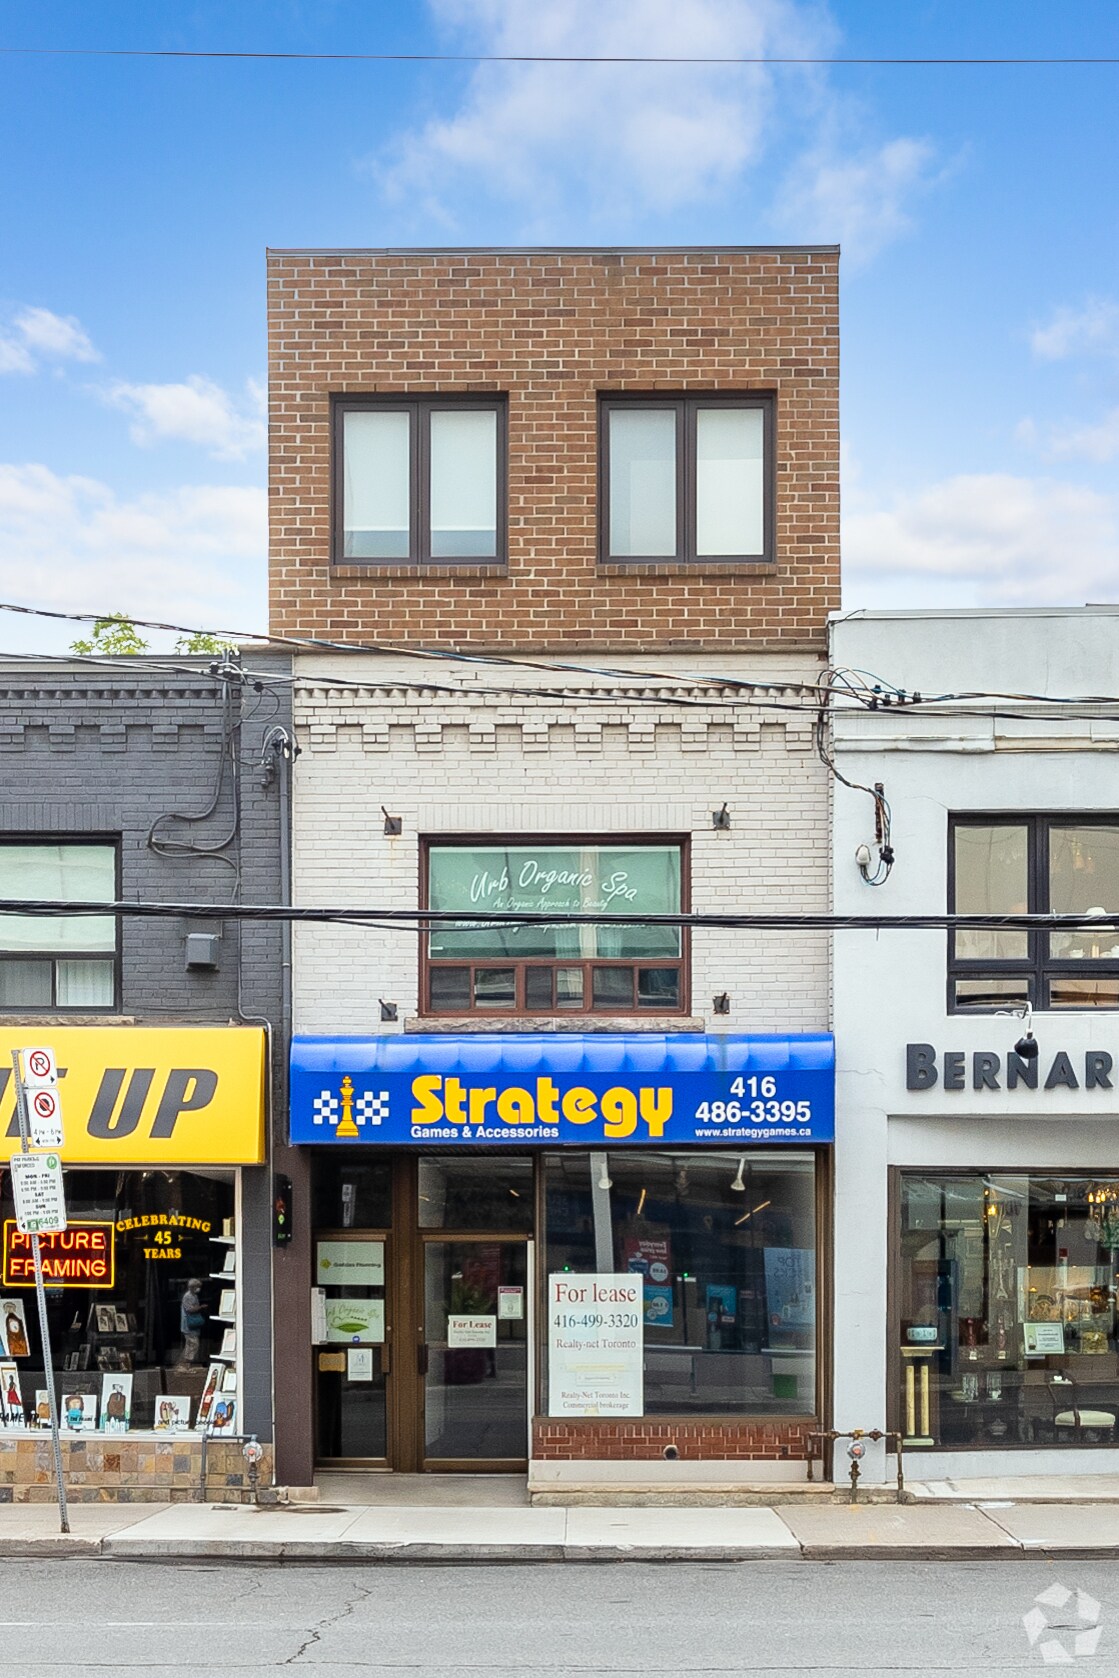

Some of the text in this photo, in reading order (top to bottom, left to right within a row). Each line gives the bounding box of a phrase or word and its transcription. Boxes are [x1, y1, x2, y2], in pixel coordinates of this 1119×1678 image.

[470, 860, 638, 903] Urb Organic Spa
[493, 897, 608, 911] An Organic Approach to Beauty
[906, 1043, 1114, 1091] BERNAR
[730, 1077, 776, 1098] 416
[86, 1067, 219, 1139] UP
[410, 1074, 673, 1137] Strategy
[695, 1101, 811, 1123] 486-3395
[411, 1125, 559, 1138] Games & Accessories
[695, 1127, 812, 1138] www.strategygames.ca
[38, 1216, 59, 1225] 6409
[116, 1213, 212, 1232] CELEBRATING
[11, 1231, 105, 1250] PICTURE
[154, 1230, 172, 1245] 45
[143, 1247, 182, 1259] YEARS
[555, 1283, 588, 1303] For
[593, 1283, 637, 1303] lease
[452, 1320, 492, 1328] For Lease
[553, 1313, 638, 1329] 416-499-3320
[556, 1339, 637, 1351] Realty-net Toronto
[561, 1391, 593, 1400] Realty-Net
[594, 1391, 619, 1399] Toronto
[562, 1401, 629, 1410] Commercial brokerage
